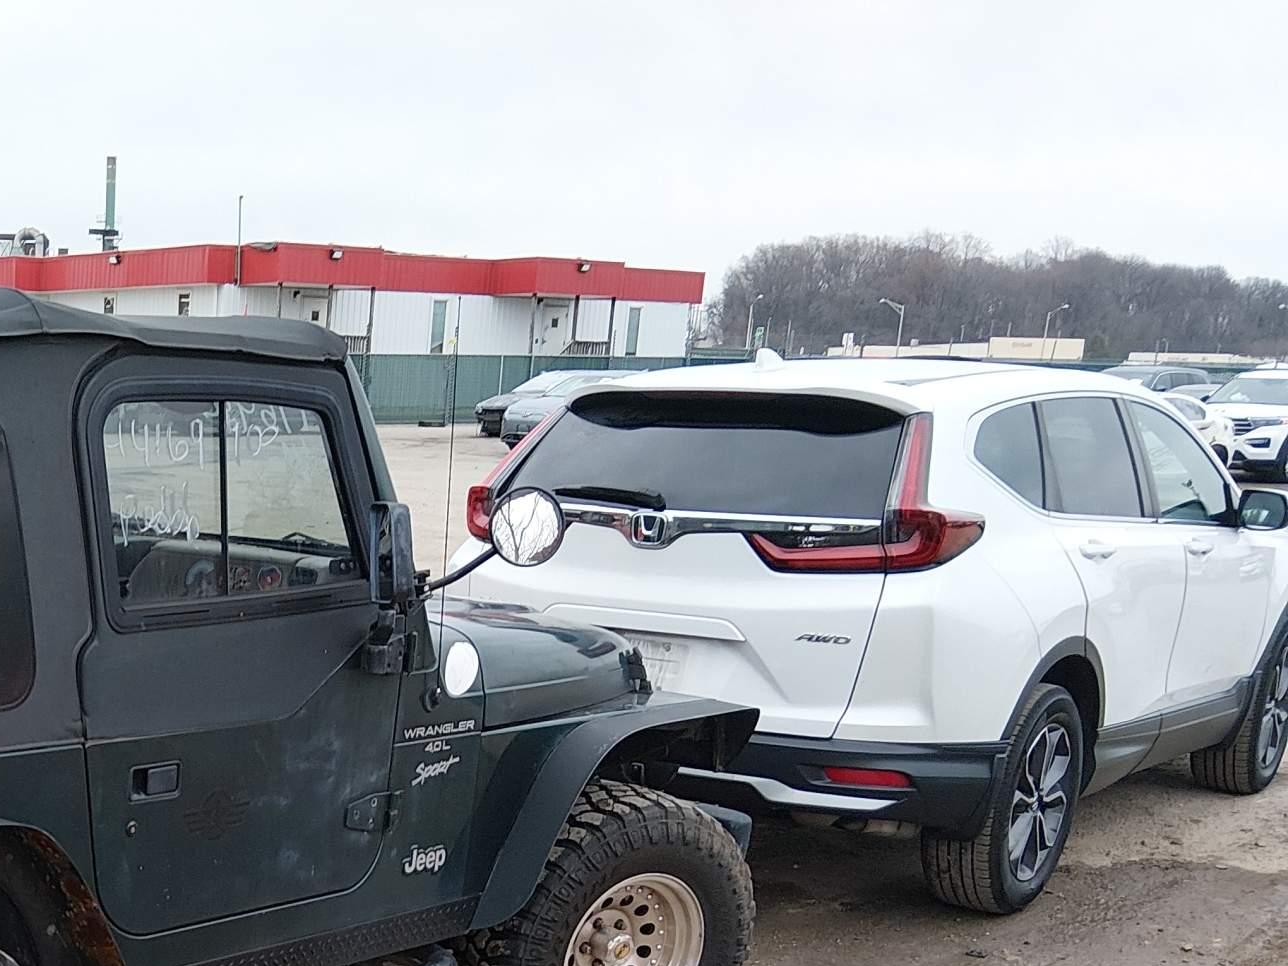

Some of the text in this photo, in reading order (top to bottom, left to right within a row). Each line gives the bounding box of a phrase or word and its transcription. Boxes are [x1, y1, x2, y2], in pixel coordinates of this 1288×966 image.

[794, 633, 852, 645] AWD
[403, 719, 475, 740] WRANGLER
[411, 754, 460, 786] Sport
[403, 846, 447, 874] Jeep
